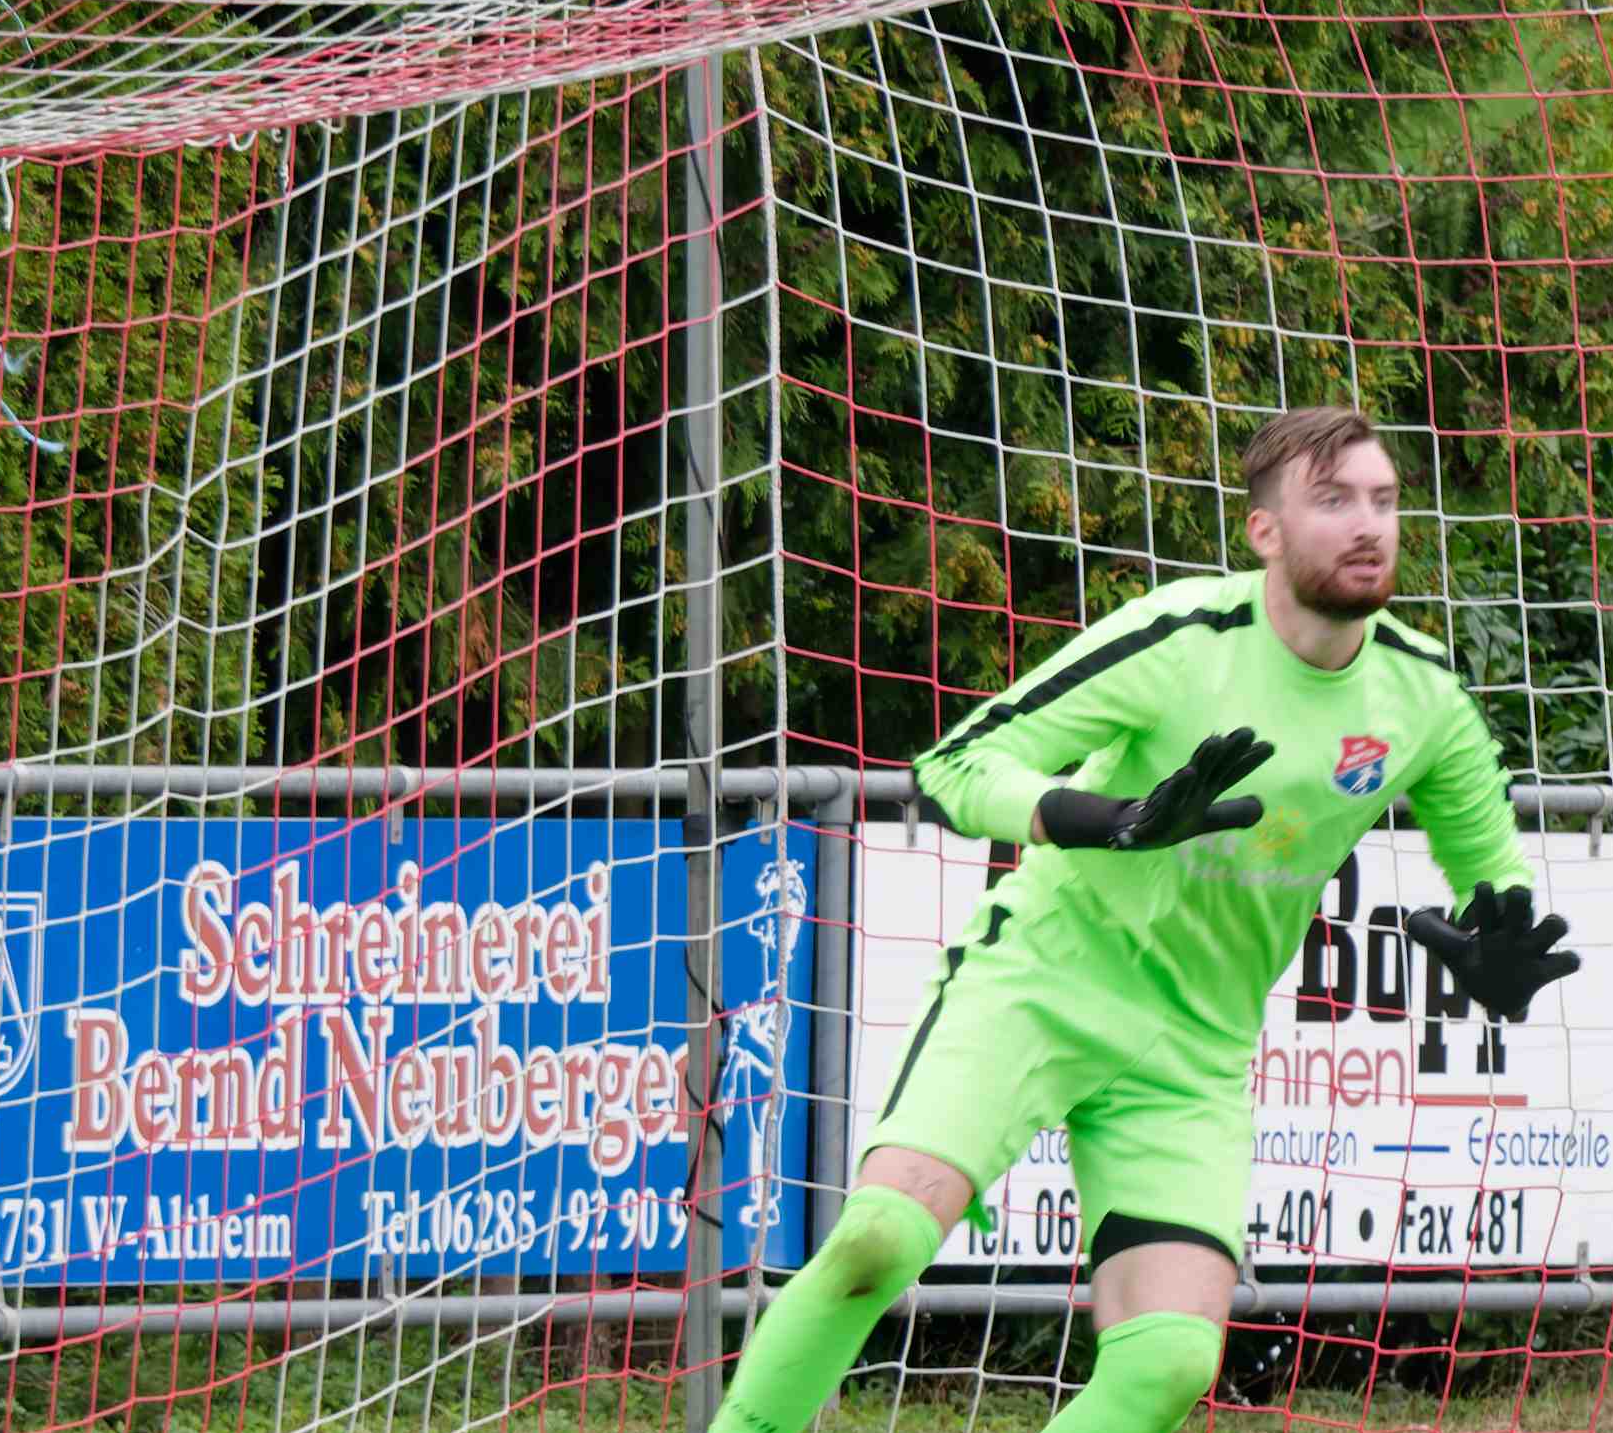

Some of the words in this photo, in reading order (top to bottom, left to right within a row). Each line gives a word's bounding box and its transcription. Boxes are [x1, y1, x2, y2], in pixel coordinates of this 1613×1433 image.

[179, 860, 611, 1006] Schreinerei
[63, 1007, 304, 1152] Bernd
[1252, 1029, 1407, 1106] hinen
[1468, 1118, 1610, 1169] Ersatzteile
[569, 1188, 609, 1251] 92
[620, 1187, 660, 1251] 90
[668, 1186, 688, 1250] 9
[1036, 1188, 1077, 1256] 06
[1399, 1190, 1454, 1255] Fax
[1466, 1189, 1525, 1255] 481
